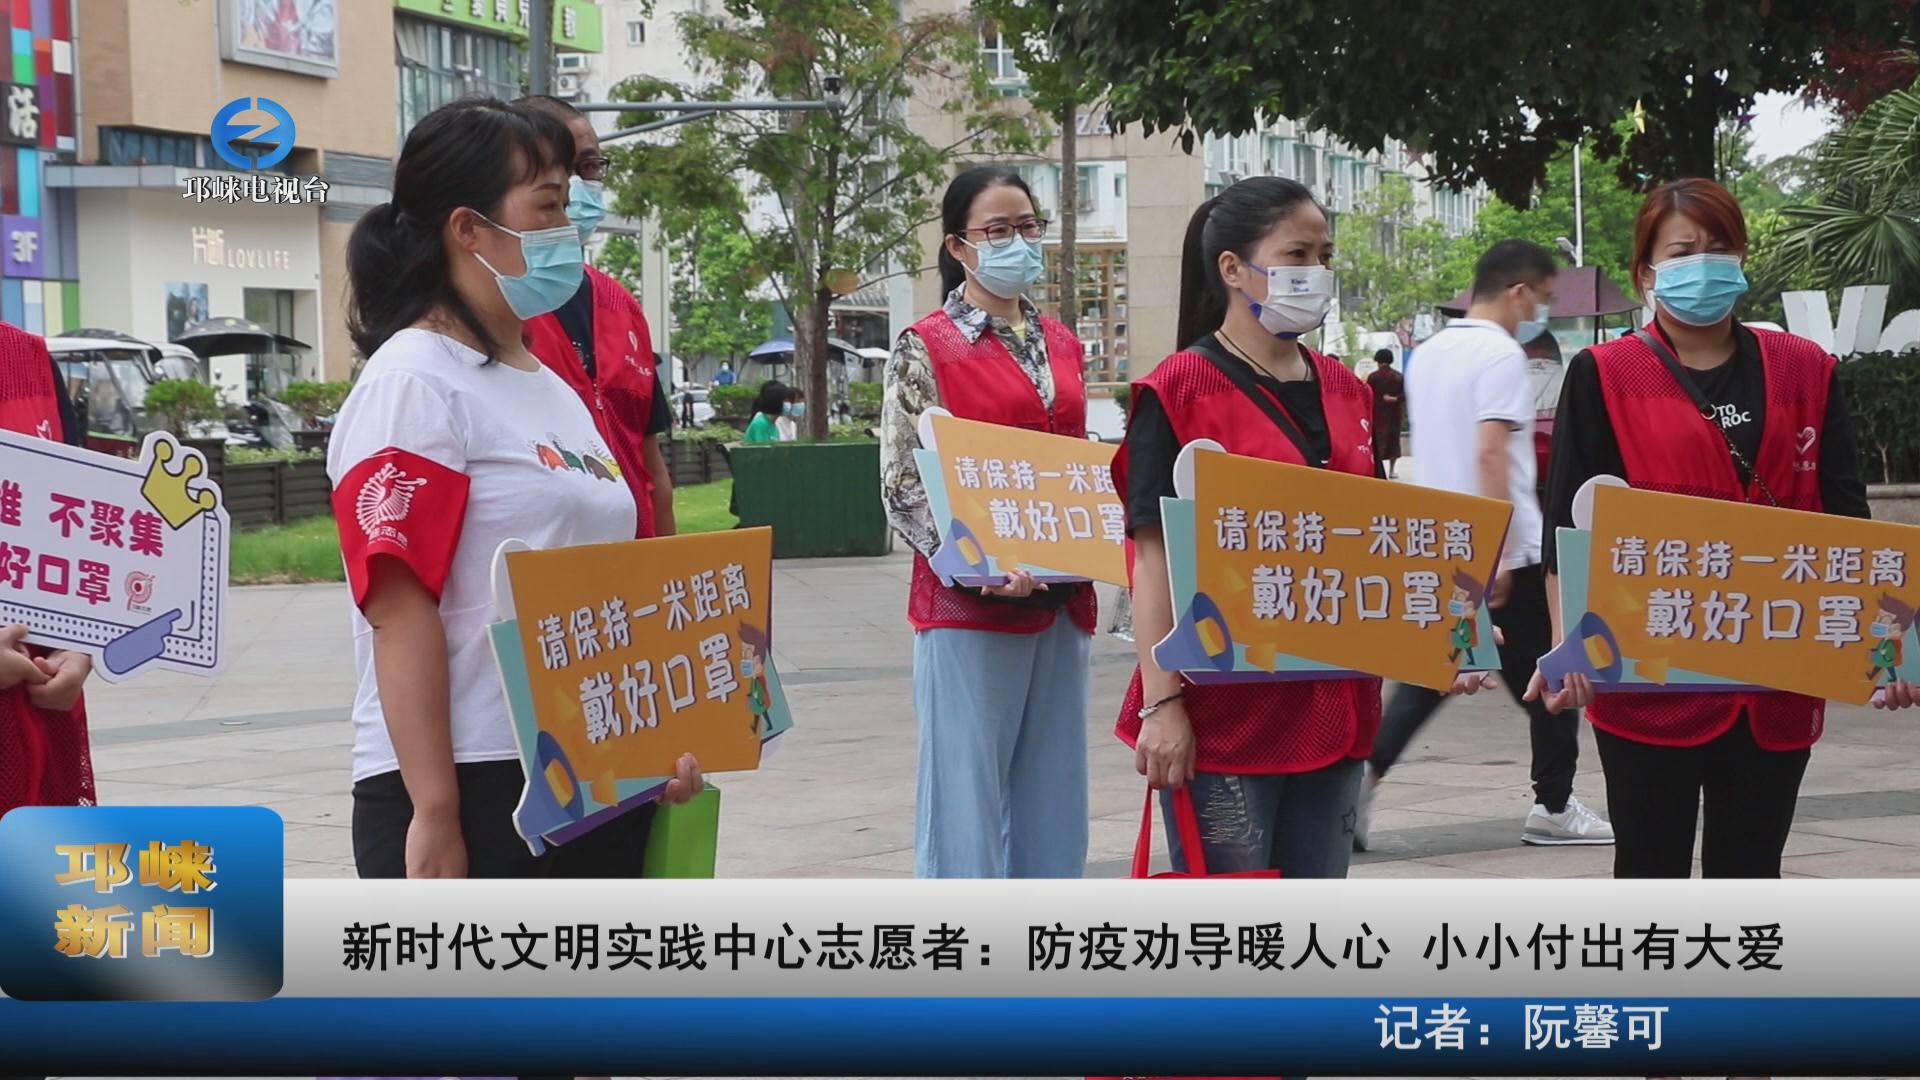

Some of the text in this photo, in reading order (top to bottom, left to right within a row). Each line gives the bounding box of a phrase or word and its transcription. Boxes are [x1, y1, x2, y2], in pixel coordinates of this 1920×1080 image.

[49, 492, 164, 558] 不聚集
[988, 497, 1126, 546] 戴好口罩
[1213, 506, 1475, 562] 请保持一米距离
[1610, 535, 1907, 588] 请保持一米距离
[537, 562, 751, 671] 请保持一米距离
[1251, 563, 1443, 629] 戴好口罩
[1645, 586, 1864, 649] 戴好口罩
[578, 632, 740, 745] 戴好口罩
